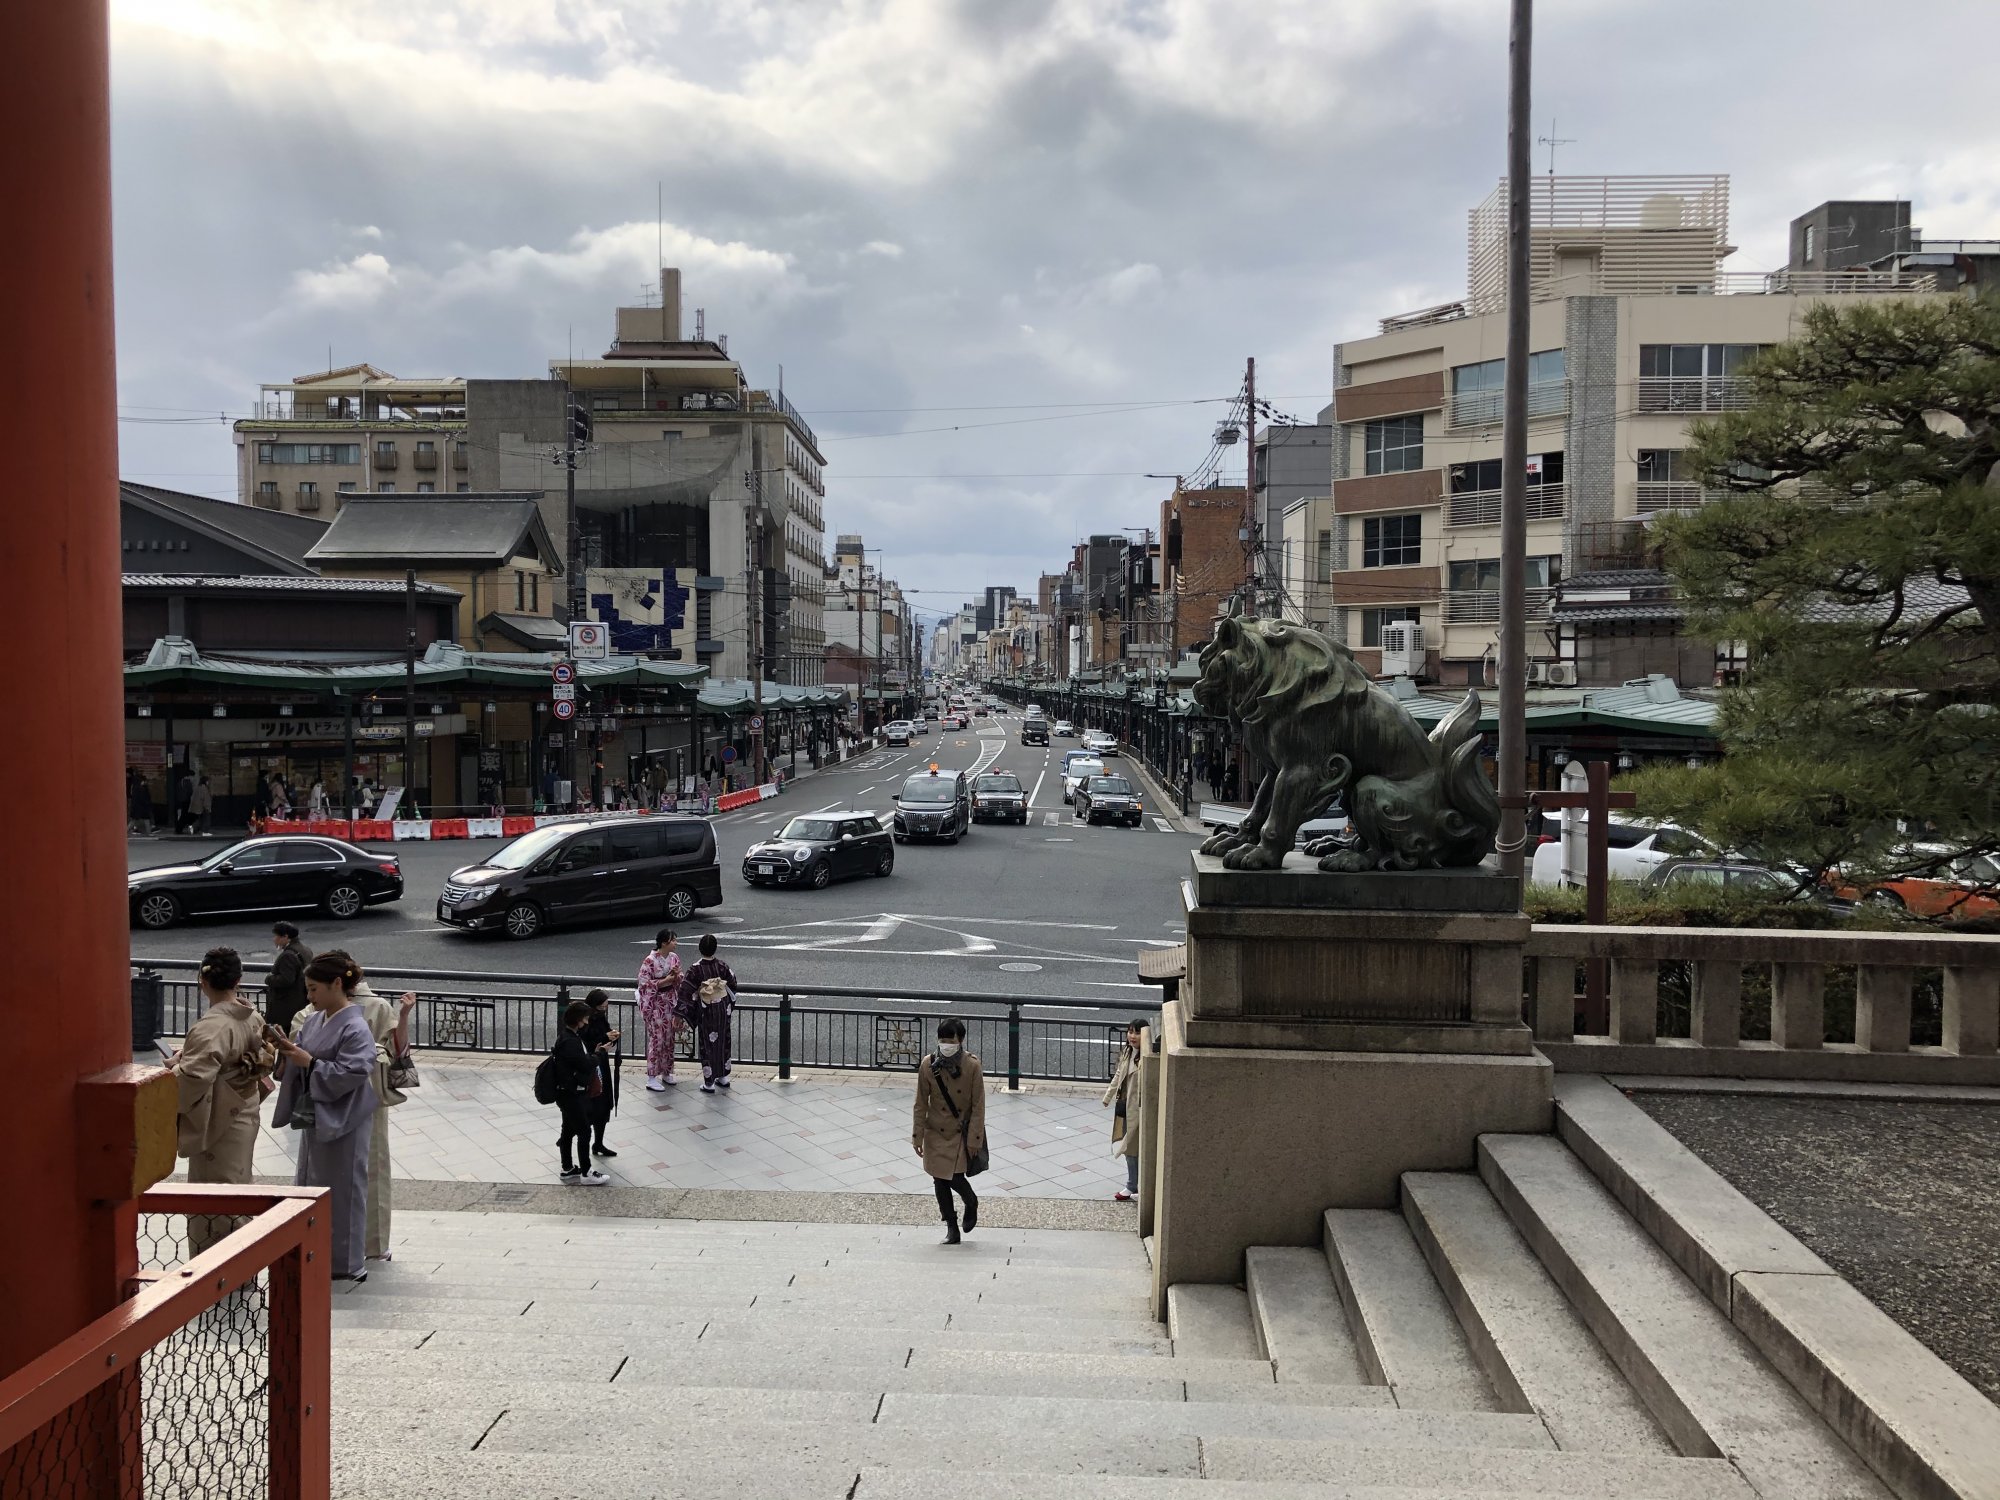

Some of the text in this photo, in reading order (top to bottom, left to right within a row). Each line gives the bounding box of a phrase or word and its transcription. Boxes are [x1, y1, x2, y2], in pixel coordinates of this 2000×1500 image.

[559, 705, 569, 713] 40
[261, 722, 312, 736] ツルハ
